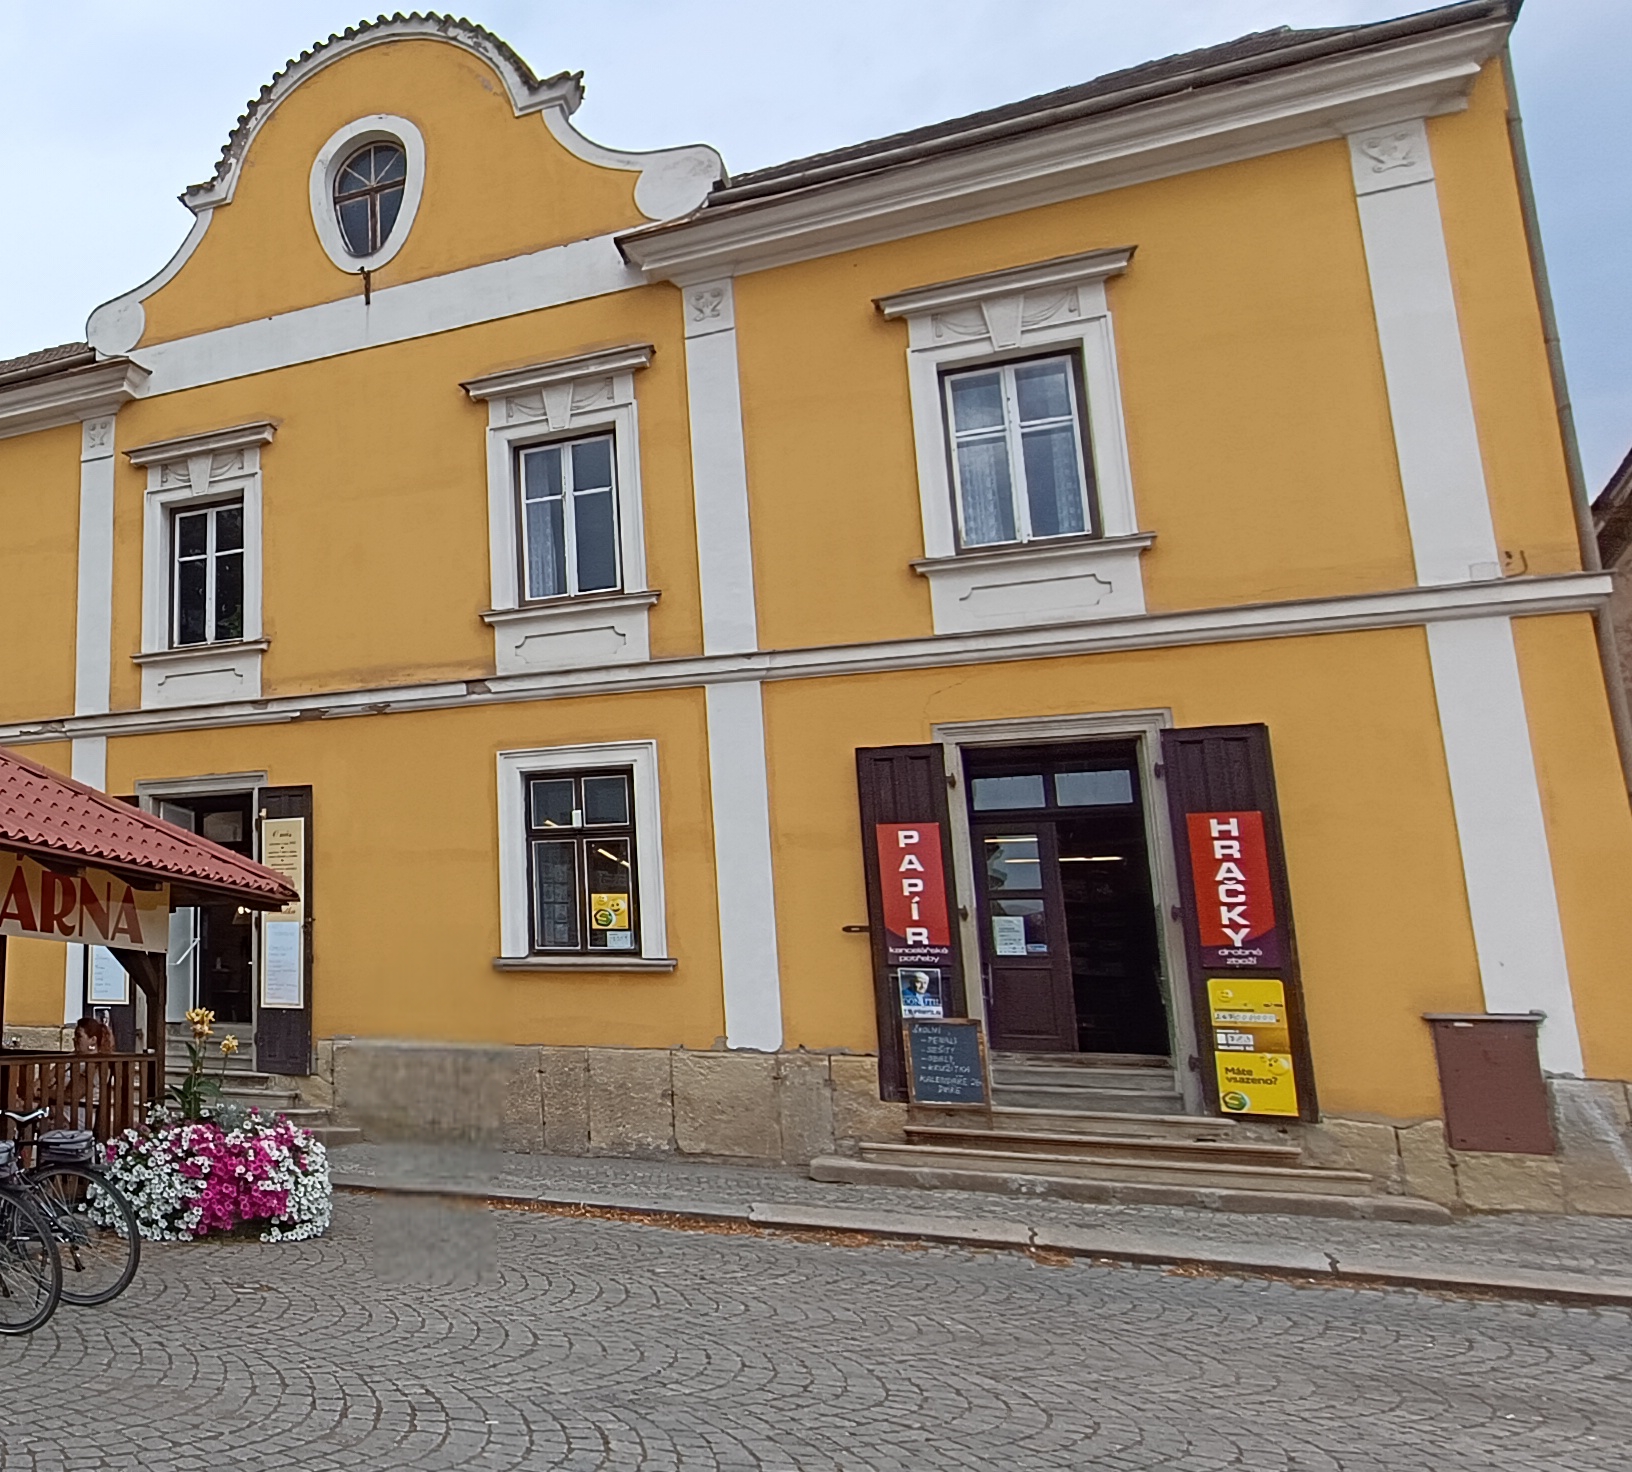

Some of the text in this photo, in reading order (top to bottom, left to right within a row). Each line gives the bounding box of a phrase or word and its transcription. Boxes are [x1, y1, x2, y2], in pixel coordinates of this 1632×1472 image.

[1209, 818, 1251, 947] HRAČKY
[897, 830, 930, 946] PAPÍR
[898, 955, 940, 963] potřeby
[1224, 1066, 1253, 1076] Máte
[1225, 1076, 1278, 1085] vsazeno?
